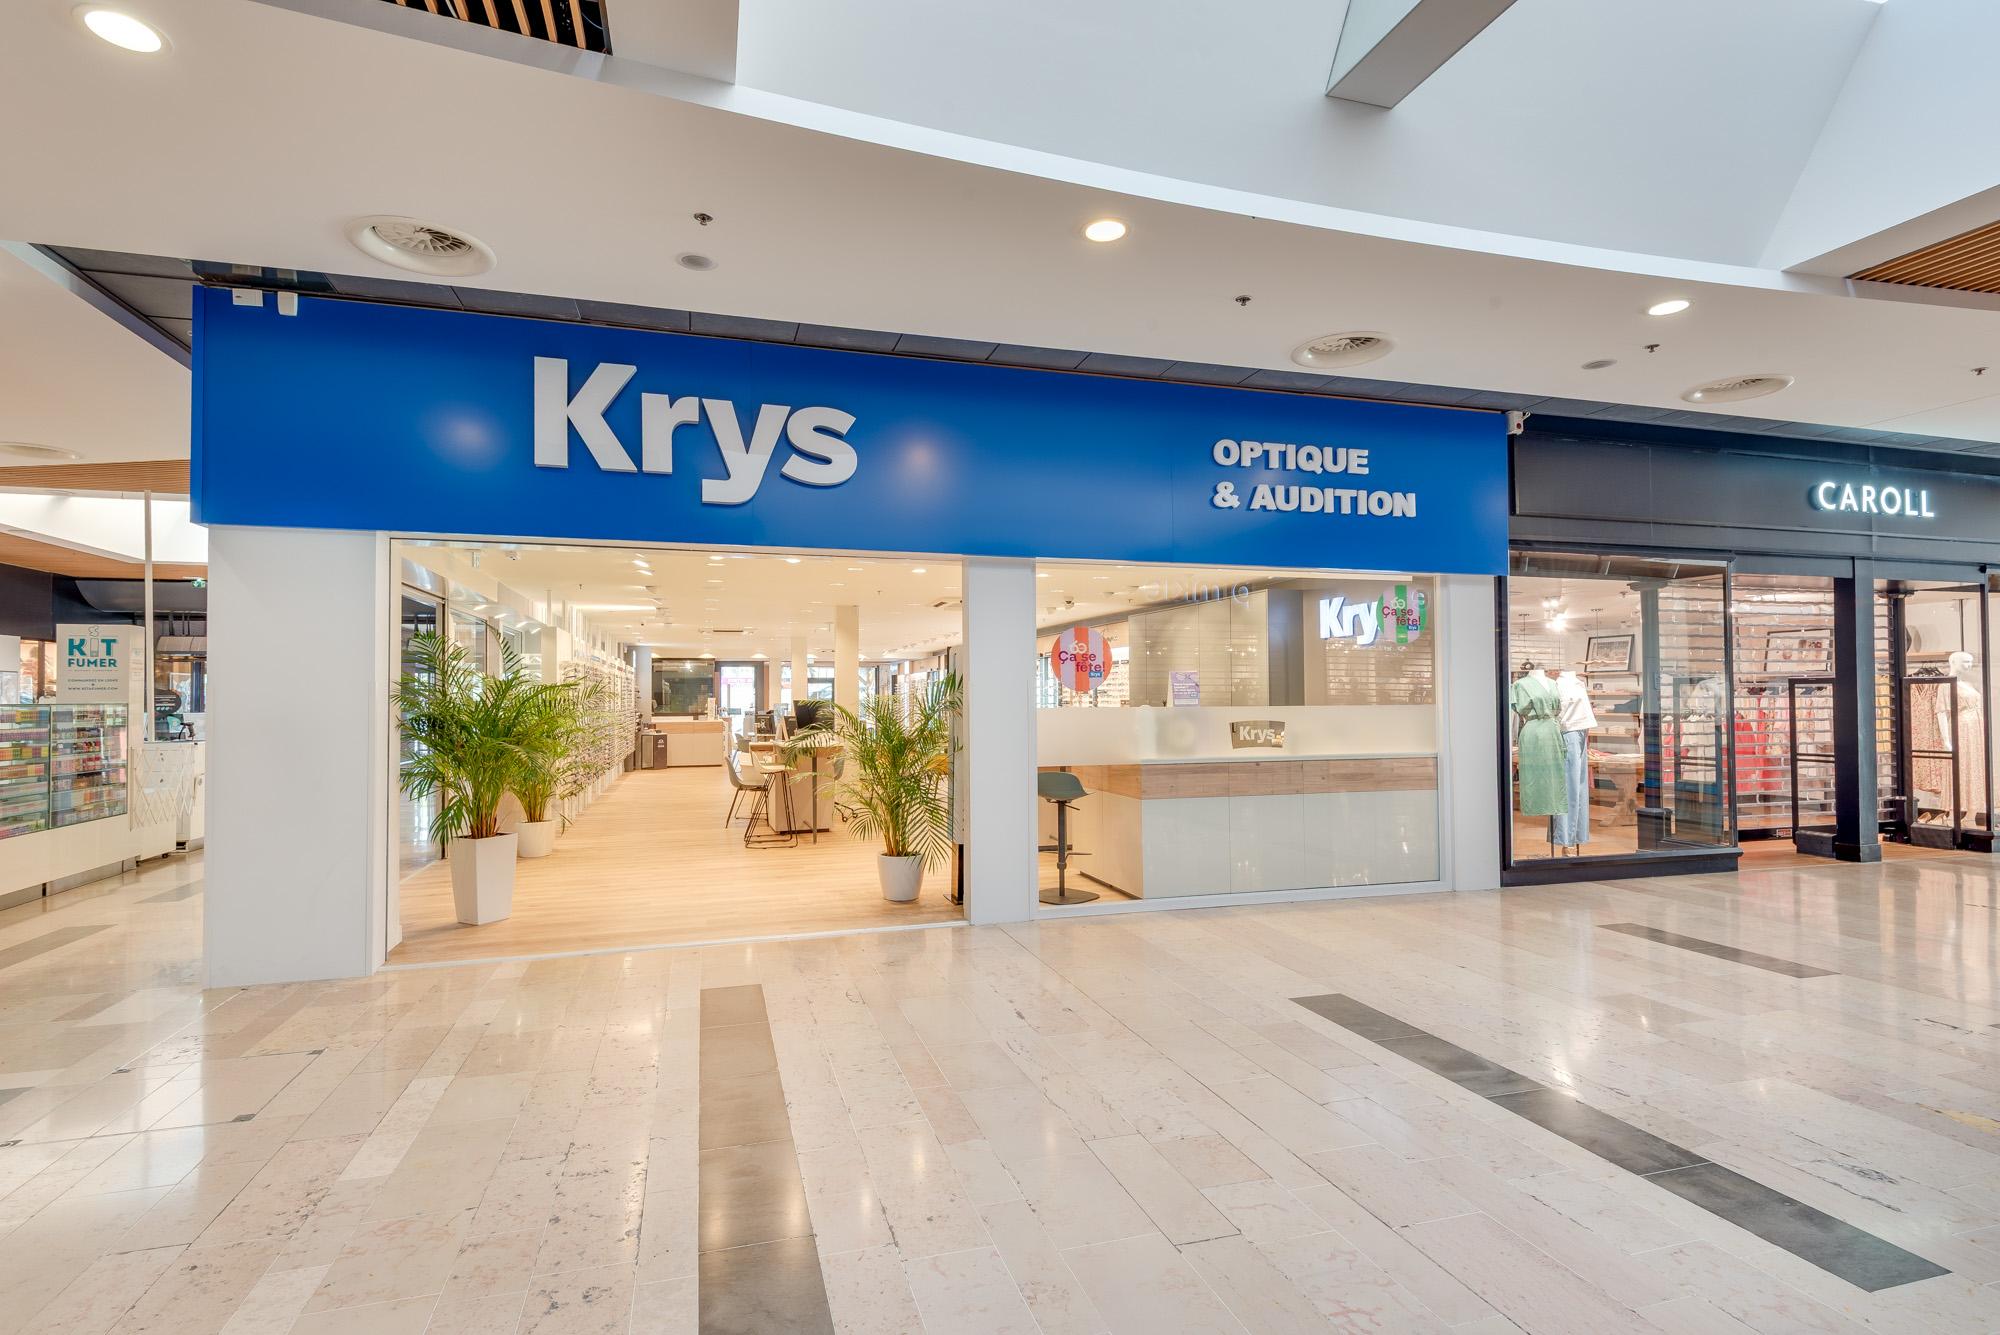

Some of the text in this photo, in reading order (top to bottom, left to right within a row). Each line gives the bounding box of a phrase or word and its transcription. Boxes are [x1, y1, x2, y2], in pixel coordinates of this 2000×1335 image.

[534, 356, 857, 505] Krys
[1213, 439, 1369, 475] OPTIQUE
[1212, 481, 1417, 518] & AUDITION
[1817, 481, 1935, 518] CAROLL
[1319, 596, 1381, 646] Kry
[1382, 606, 1414, 618] Ça se
[68, 658, 117, 667] FUMER
[1058, 650, 1097, 664] Ça se
[1076, 661, 1105, 672] fête!
[1239, 725, 1275, 744] Krys
